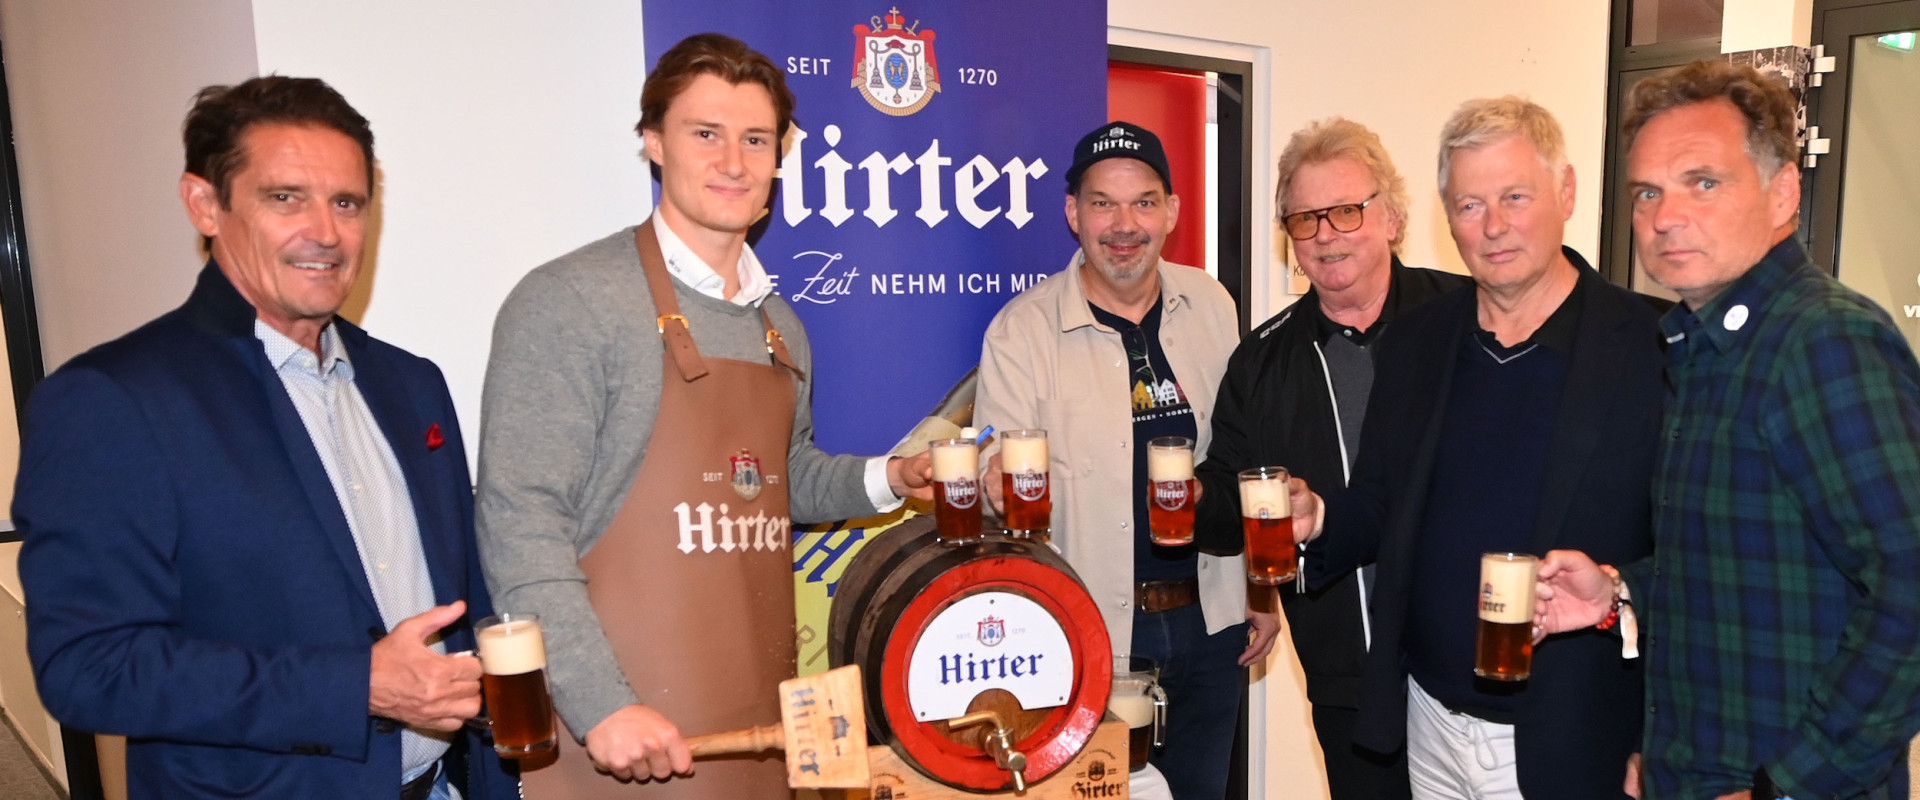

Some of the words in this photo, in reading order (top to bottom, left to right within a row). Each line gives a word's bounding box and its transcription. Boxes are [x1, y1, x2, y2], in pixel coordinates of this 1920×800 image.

[787, 57, 831, 76] SEIT
[959, 67, 997, 86] 1270
[1093, 138, 1141, 153] Hirter
[792, 251, 860, 304] Zeit
[871, 274, 946, 294] NEHM
[959, 274, 1000, 294] ICH
[703, 472, 723, 482] SEIT
[947, 486, 977, 498] Hirter
[1156, 488, 1185, 499] Hirter
[673, 501, 790, 554] Hirter
[939, 653, 1044, 685] Hirter
